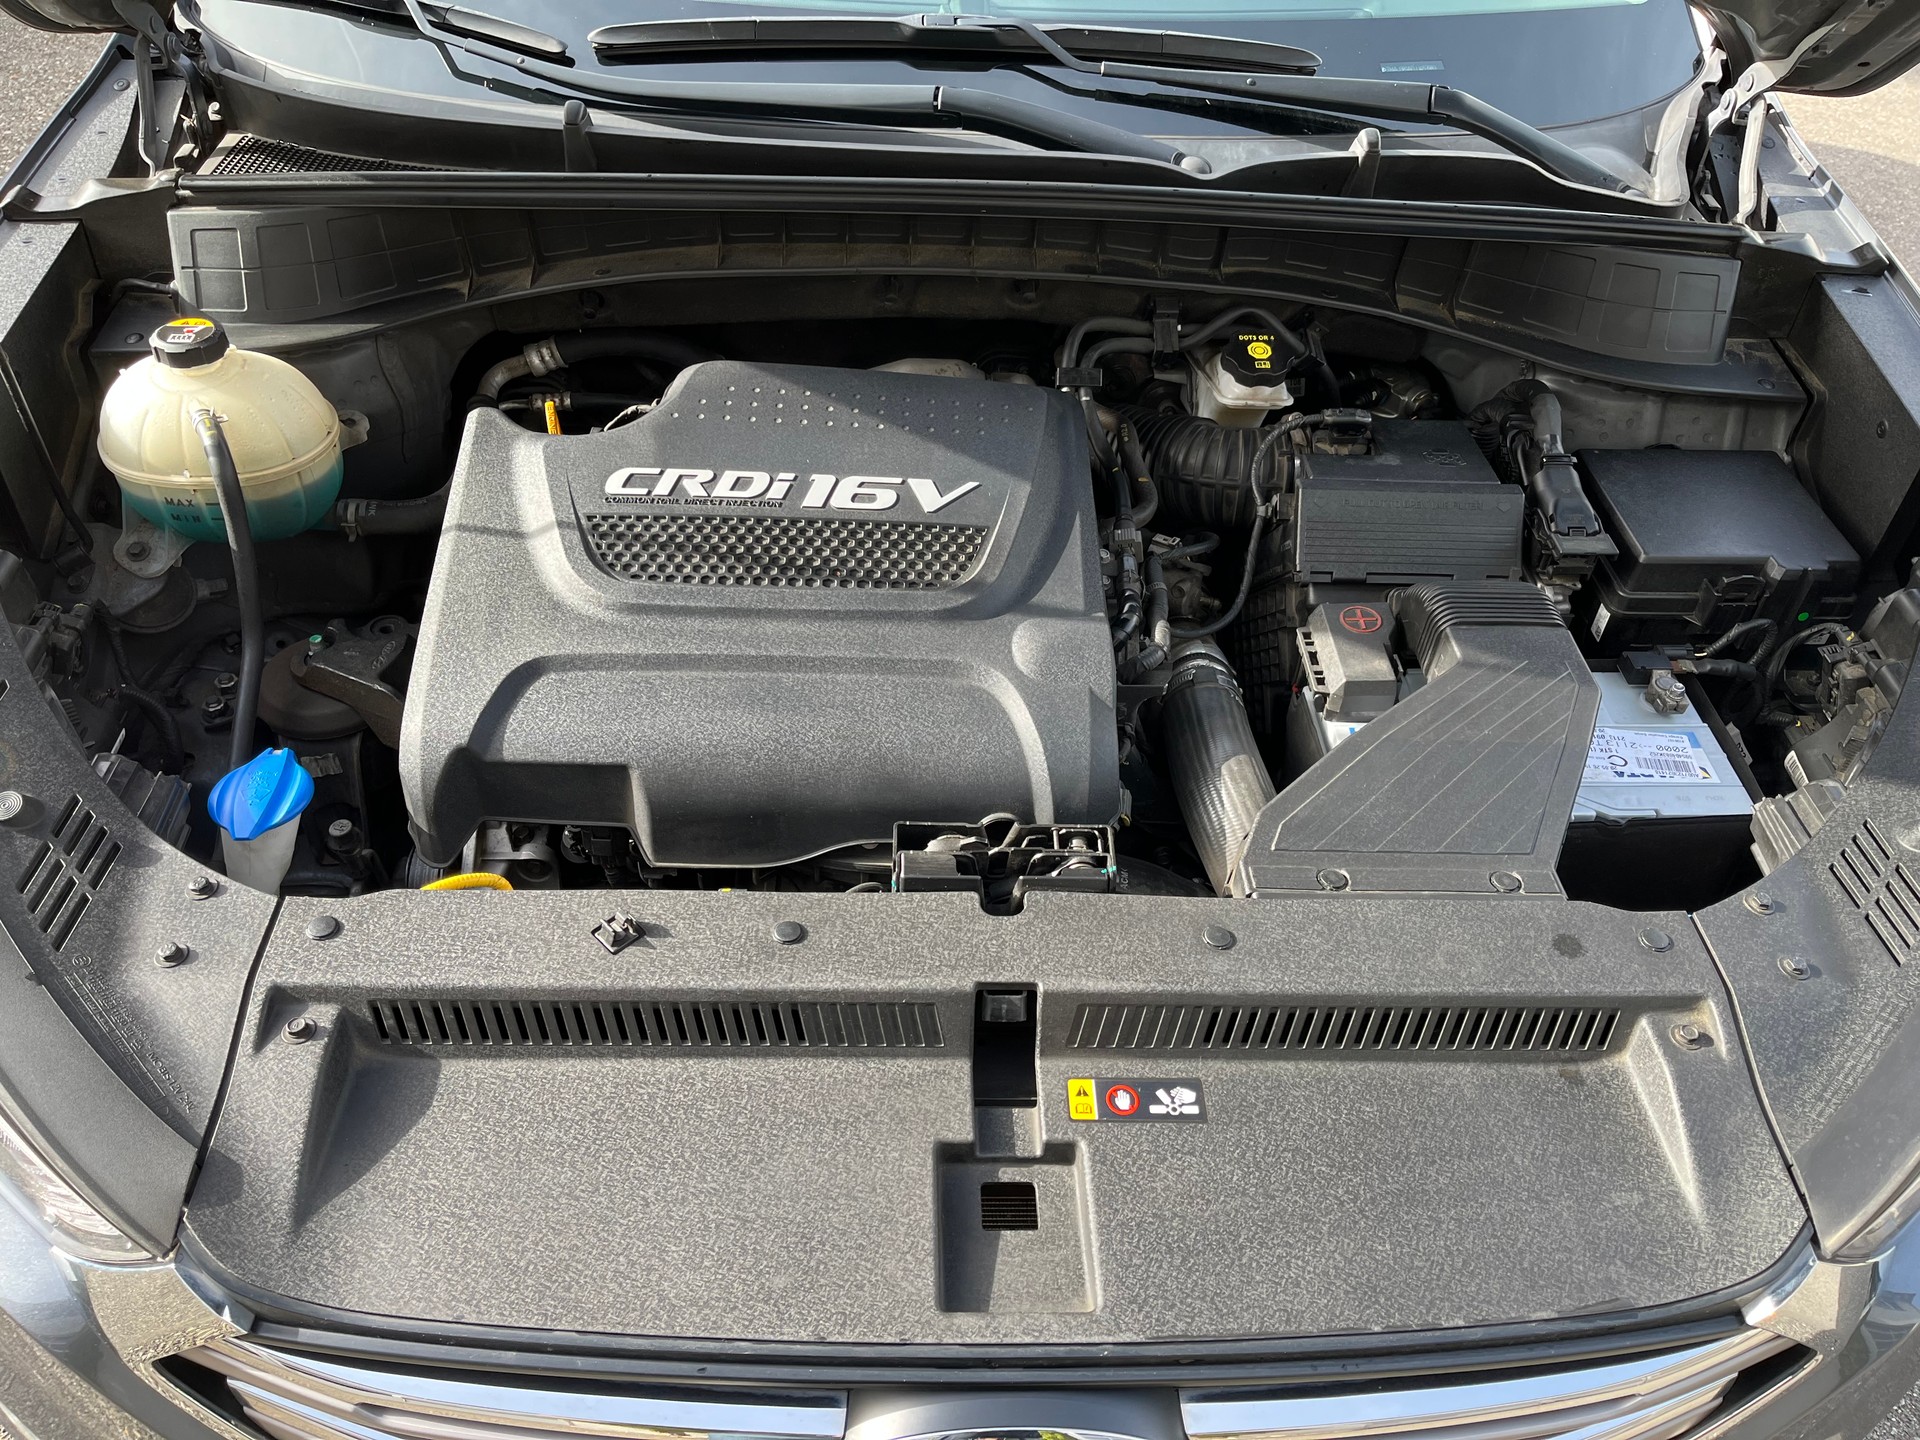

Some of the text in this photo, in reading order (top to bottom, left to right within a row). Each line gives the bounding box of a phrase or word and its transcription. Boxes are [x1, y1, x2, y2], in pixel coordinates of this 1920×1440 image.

[604, 467, 982, 514] CRDi 16V
[164, 496, 195, 508] MAX
[604, 496, 783, 508] COMMON RAIL DIRECT INJECTION
[171, 513, 201, 523] MIN
[1656, 744, 1689, 754] 2000
